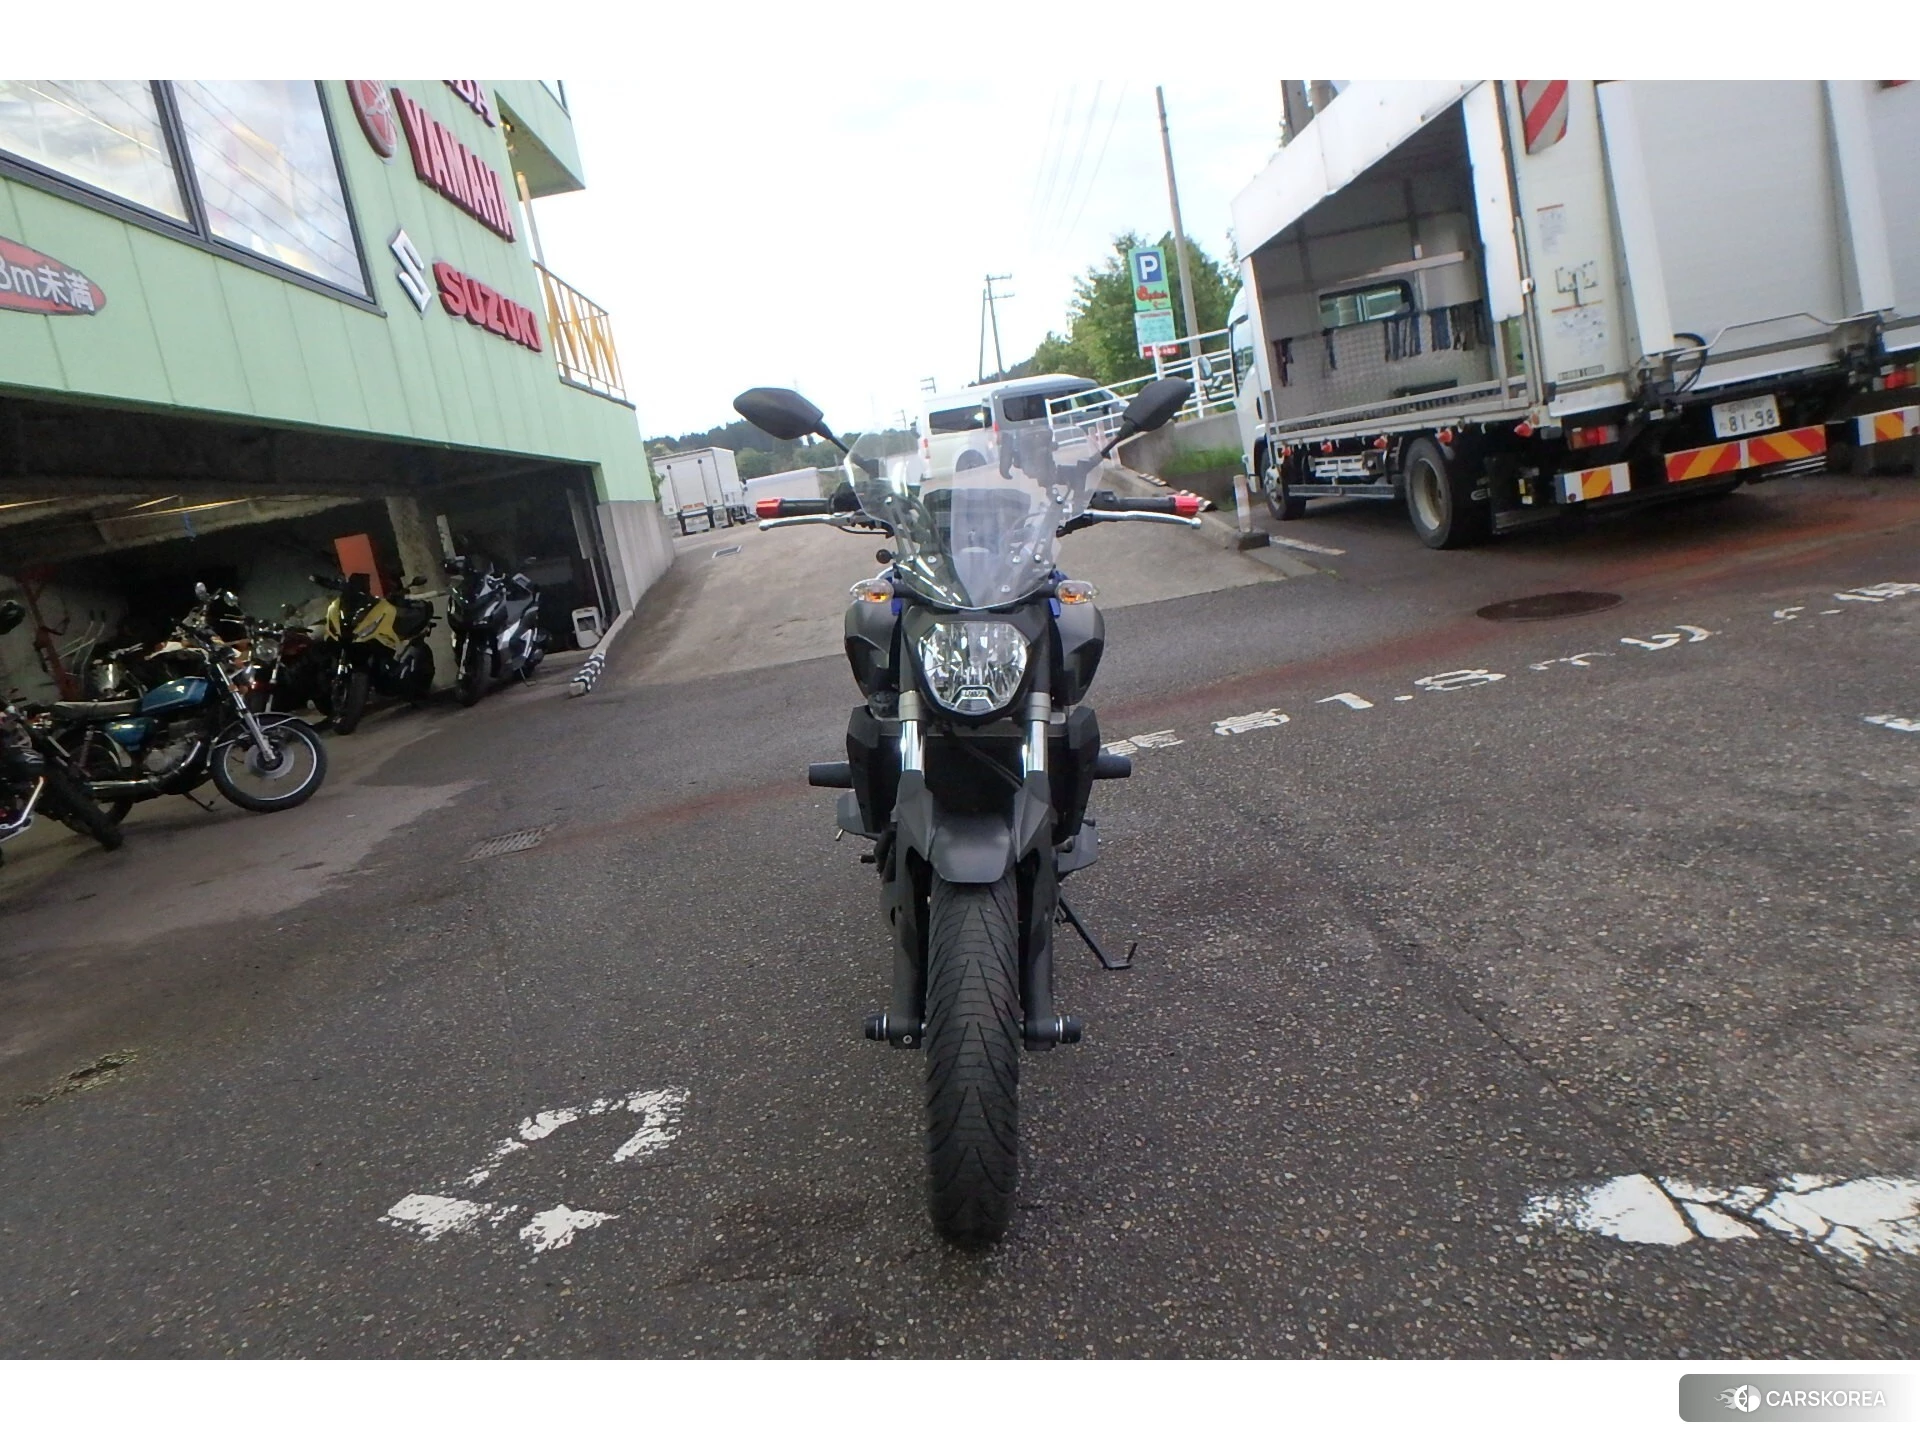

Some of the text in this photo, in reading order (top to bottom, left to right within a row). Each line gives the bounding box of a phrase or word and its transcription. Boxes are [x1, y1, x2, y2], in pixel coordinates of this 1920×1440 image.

[391, 88, 516, 242] YAMAHA
[433, 262, 543, 352] SUZUKI
[1139, 255, 1158, 280] P
